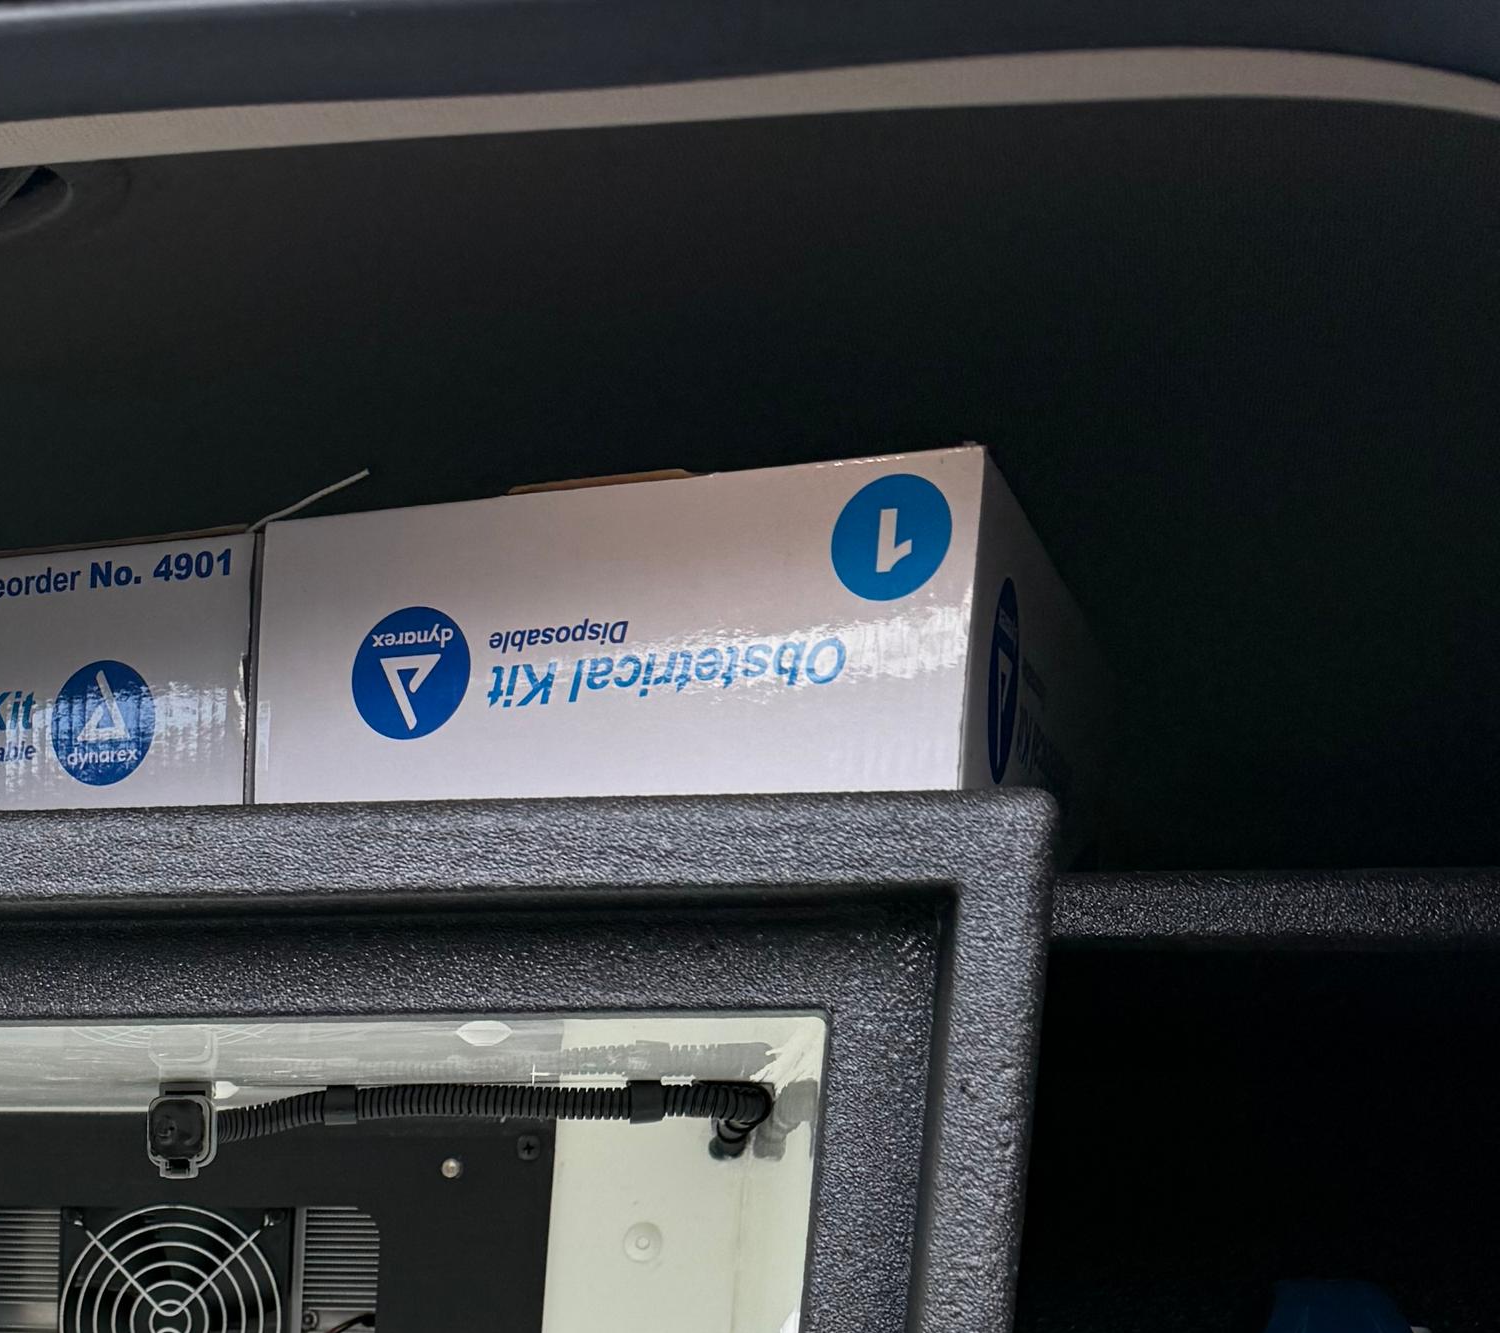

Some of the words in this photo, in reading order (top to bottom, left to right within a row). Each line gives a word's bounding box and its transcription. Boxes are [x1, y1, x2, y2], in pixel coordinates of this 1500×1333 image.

[875, 508, 912, 572] 1
[88, 559, 143, 588] No.
[153, 549, 233, 583] 4901
[371, 629, 454, 651] dynarex
[489, 620, 630, 652] Disposable
[488, 662, 556, 709] Kit
[569, 636, 847, 703] Obstetrical
[66, 746, 140, 769] dynarex
